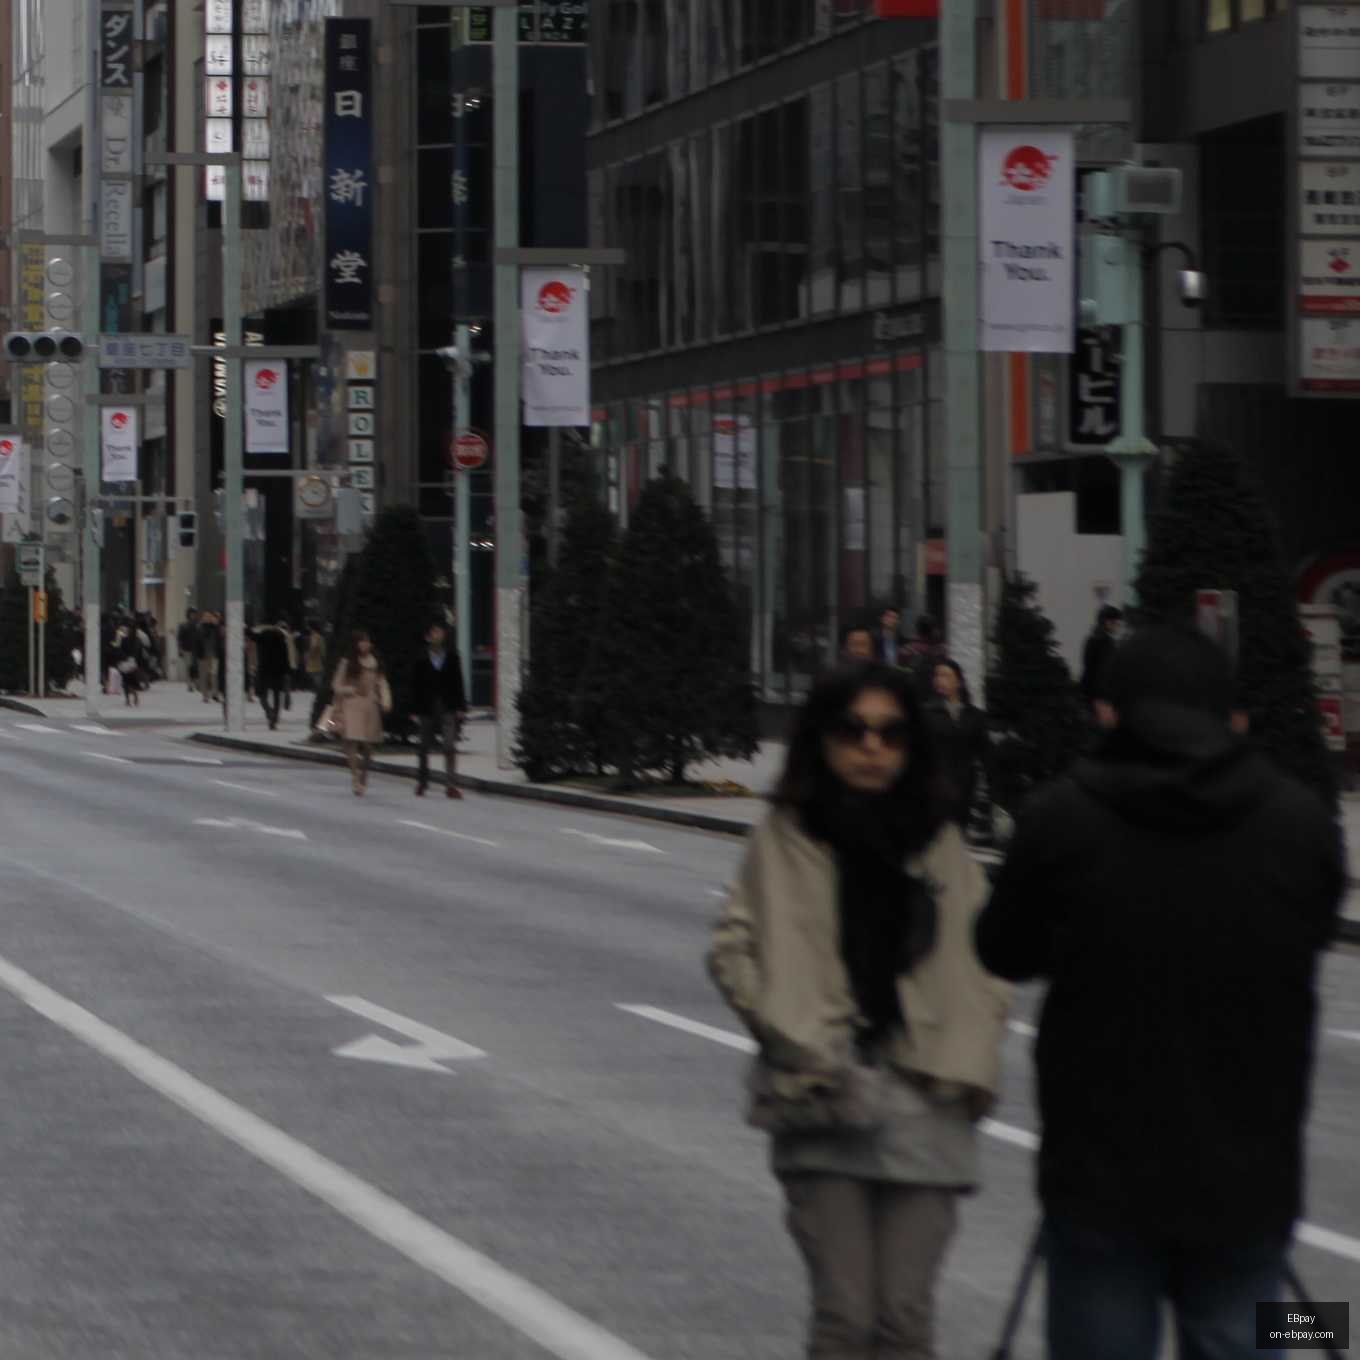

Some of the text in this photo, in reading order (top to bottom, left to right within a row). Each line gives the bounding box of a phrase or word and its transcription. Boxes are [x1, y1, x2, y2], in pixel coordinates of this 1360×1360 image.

[104, 14, 129, 85] ダンス
[330, 90, 369, 285] 日新堂
[992, 240, 1063, 259] Thank
